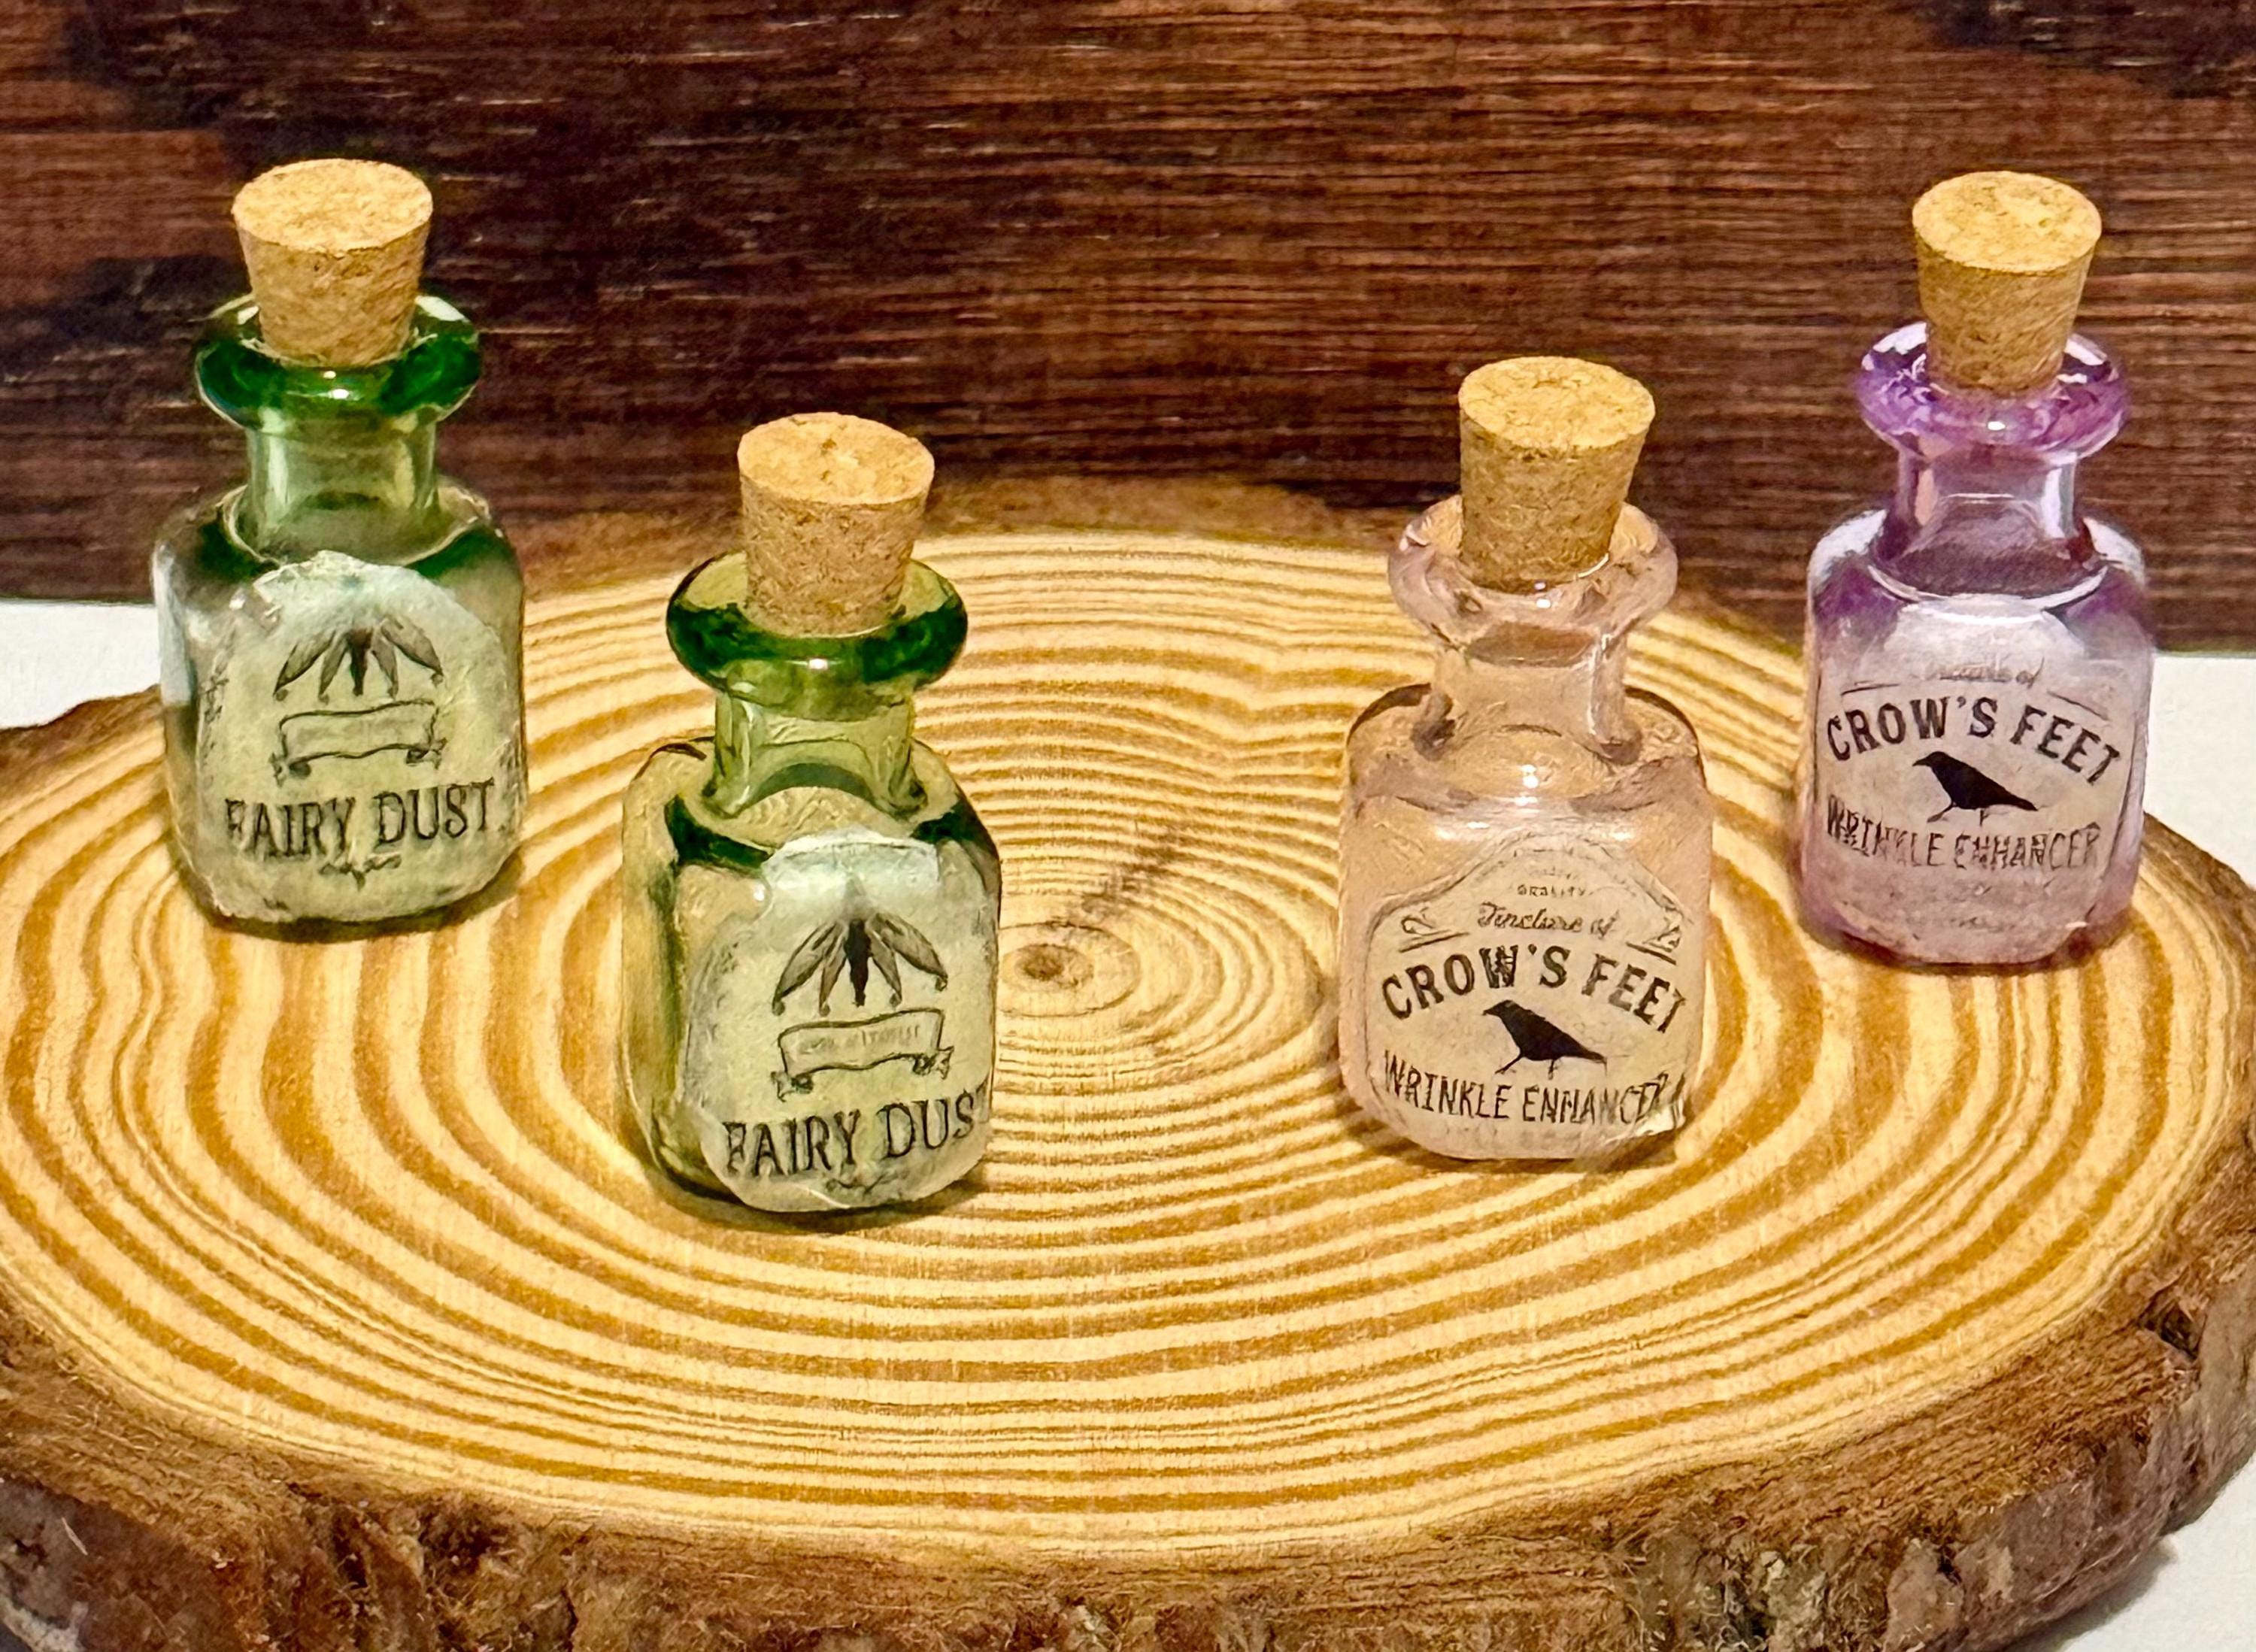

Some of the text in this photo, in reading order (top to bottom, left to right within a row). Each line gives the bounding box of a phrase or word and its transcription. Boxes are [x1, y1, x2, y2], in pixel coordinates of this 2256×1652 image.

[1827, 696, 2121, 786] CROW'S FEET
[225, 777, 495, 859] FAIRY DUST
[1381, 944, 1687, 1034] CROW'S FEET
[1384, 1049, 1513, 1120] WRINKLE
[722, 1109, 861, 1176] FAIRY
